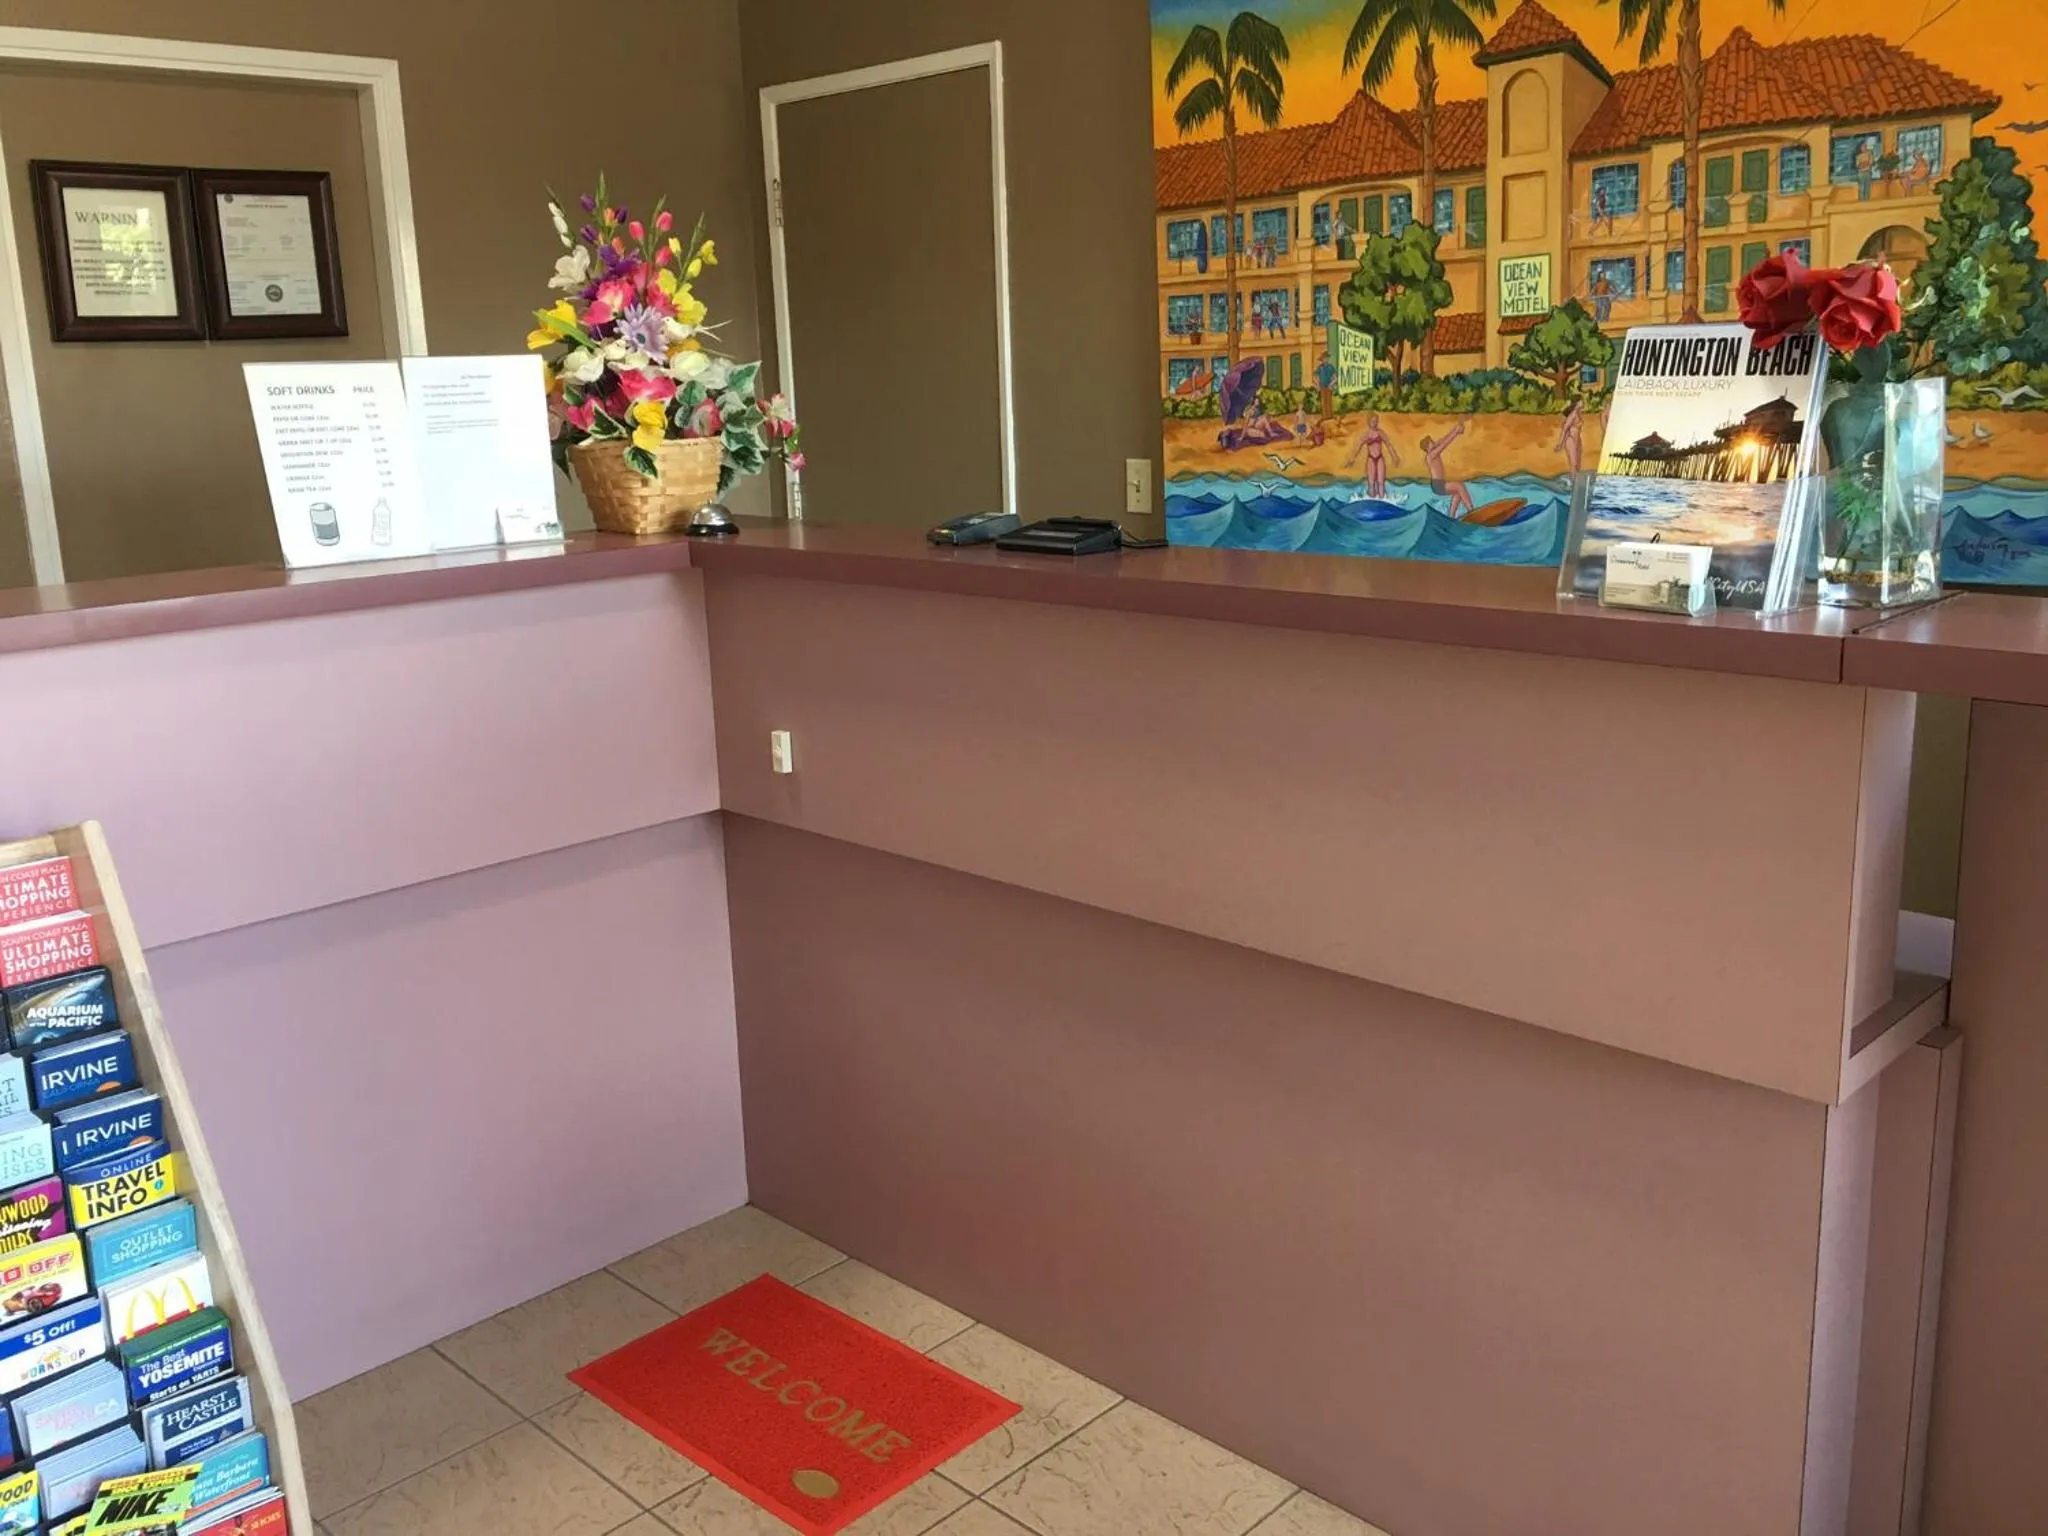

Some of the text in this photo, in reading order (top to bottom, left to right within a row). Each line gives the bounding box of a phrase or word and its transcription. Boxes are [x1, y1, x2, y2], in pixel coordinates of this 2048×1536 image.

[75, 210, 150, 225] WARNIN
[1503, 261, 1543, 283] OCEAN
[1506, 281, 1538, 297] VIEW
[1503, 295, 1548, 314] MOTEL
[1339, 326, 1372, 351] OCEAN
[1343, 351, 1369, 364] VIEW
[1620, 335, 1816, 378] HUNTINGTON BEACH
[266, 384, 335, 397] SOFT DRINKS
[1617, 377, 1735, 392] LAIDBACK LUXURY
[32, 929, 61, 941] COAST
[63, 922, 88, 933] PLAZA
[3, 930, 91, 961] ULTIMATE
[5, 944, 93, 974] SHOPPING
[7, 958, 94, 985] EXPERIENCE
[27, 1004, 104, 1019] AQUARIUM
[48, 1015, 102, 1028] PACIFIC
[41, 1056, 119, 1090] IRVINE
[75, 1113, 153, 1148] IRVINE
[100, 1154, 153, 1178] ONLINE
[82, 1161, 166, 1200] TRAVEL
[88, 1188, 148, 1219] INFO
[112, 1230, 184, 1264] SHOPPING
[120, 1224, 174, 1250] OUTLET
[24, 1329, 46, 1347] $5
[138, 1341, 225, 1388] YOSEMITE
[140, 1349, 186, 1375] The Best
[699, 1326, 914, 1464] WELCOME
[166, 1390, 229, 1427] HEARST
[178, 1397, 238, 1432] CASTLE
